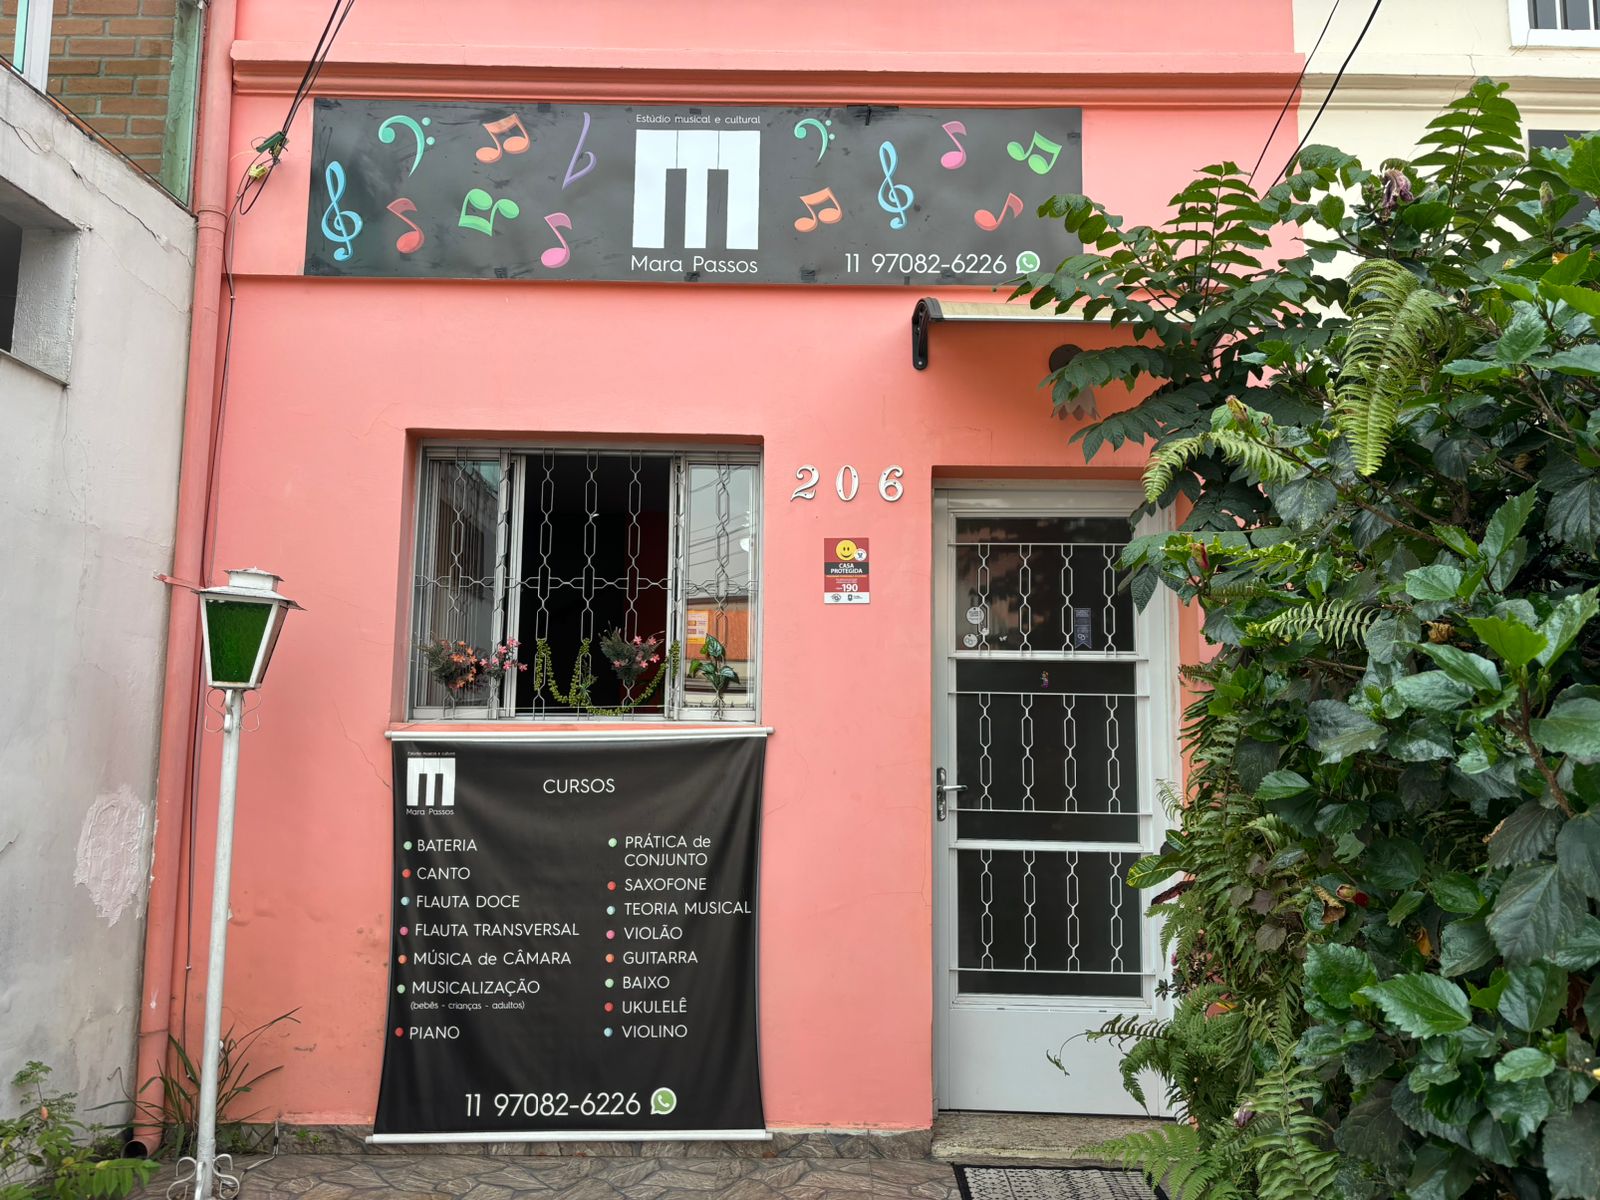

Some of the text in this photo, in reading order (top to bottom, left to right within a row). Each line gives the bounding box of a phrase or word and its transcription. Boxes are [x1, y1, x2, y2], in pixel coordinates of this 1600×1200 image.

[674, 114, 711, 124] musical
[714, 116, 721, 124] e
[724, 115, 761, 124] cultural
[630, 254, 758, 274] Mara Passos
[844, 252, 1007, 274] 11 97082-6226
[841, 583, 859, 592] 190
[542, 778, 616, 794] CURSOS
[405, 807, 455, 816] Mara Passos
[417, 838, 478, 852] BATERIA
[625, 832, 711, 849] PRÁTICA de
[624, 852, 708, 867] CONJUNTO
[416, 866, 471, 880] CANTO
[624, 877, 707, 892] SAXOFONE
[416, 894, 520, 909] FLAUTA DOCE
[624, 901, 752, 916] TEORIA MUSICAL
[415, 922, 580, 937] FLAUTA TRANSVERSAL
[623, 924, 683, 940] VIOLÃO
[413, 948, 572, 966] MÚSICA de CÂMARA
[622, 950, 699, 965] GUITARRA
[412, 978, 541, 997] MUSICALIZAÇÃO
[622, 975, 670, 990] BAIXO
[447, 1002, 482, 1012] crianças
[491, 1000, 526, 1010] adultos)
[622, 996, 687, 1015] UKULELÊ
[409, 1025, 460, 1040] PIANO
[621, 1024, 688, 1039] VIOLINO
[465, 1091, 641, 1117] 11 97082-6226
